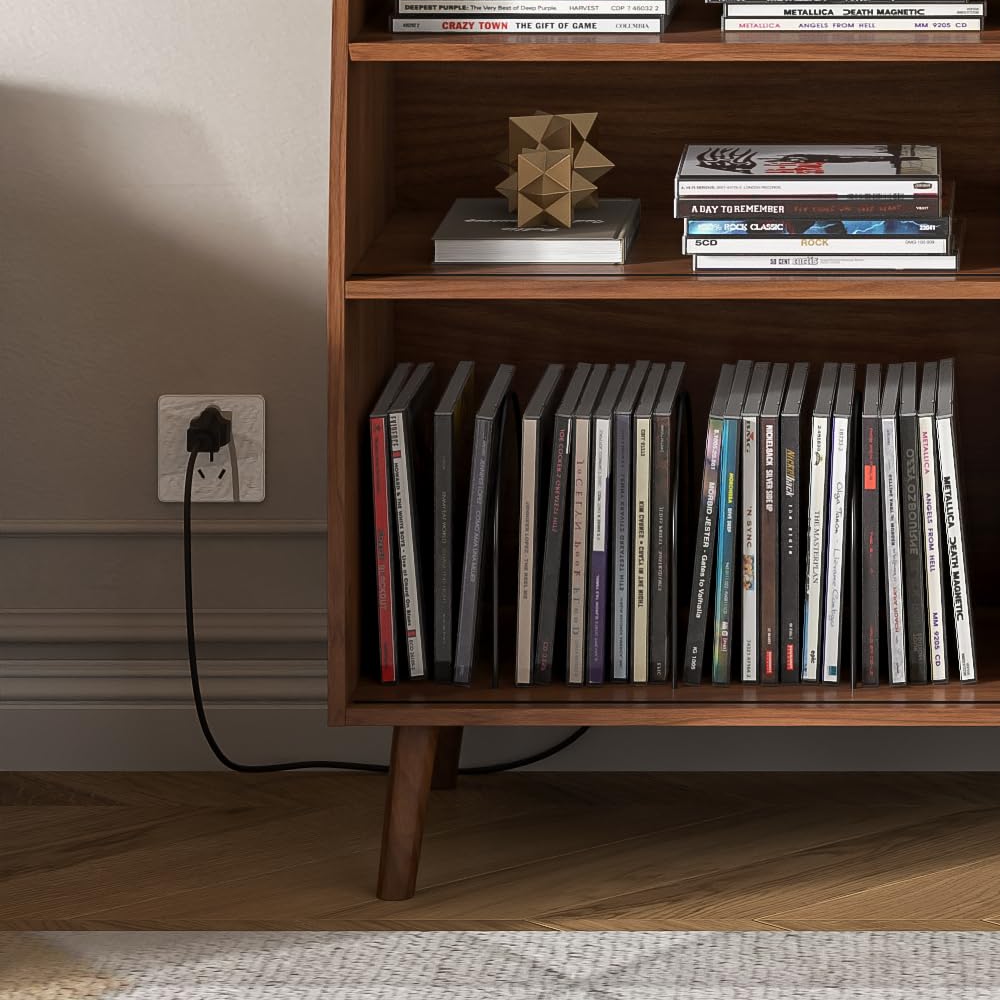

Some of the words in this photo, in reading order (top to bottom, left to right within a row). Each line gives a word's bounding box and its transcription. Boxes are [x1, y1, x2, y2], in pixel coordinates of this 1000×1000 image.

[442, 22, 475, 30] CRAZY
[478, 22, 508, 30] TOWN
[692, 205, 698, 213] A
[700, 205, 718, 213] DAY
[720, 205, 732, 213] TO
[734, 205, 784, 214] REMEMBER
[766, 424, 774, 466] NICKELBACK
[922, 431, 930, 474] METALLICA
[766, 469, 774, 490] SILVER
[706, 482, 714, 514] MORBID
[766, 490, 774, 503] SIDE
[835, 482, 843, 504] Olga
[944, 476, 954, 528] METALLICA
[766, 504, 774, 512] UP
[703, 516, 712, 548] JESTER
[949, 536, 959, 568] DEATH
[698, 579, 705, 587] to
[696, 588, 704, 618] Valhalla
[952, 572, 964, 621] MAGNETIC
[932, 612, 939, 627] MM
[935, 654, 941, 667] CD
